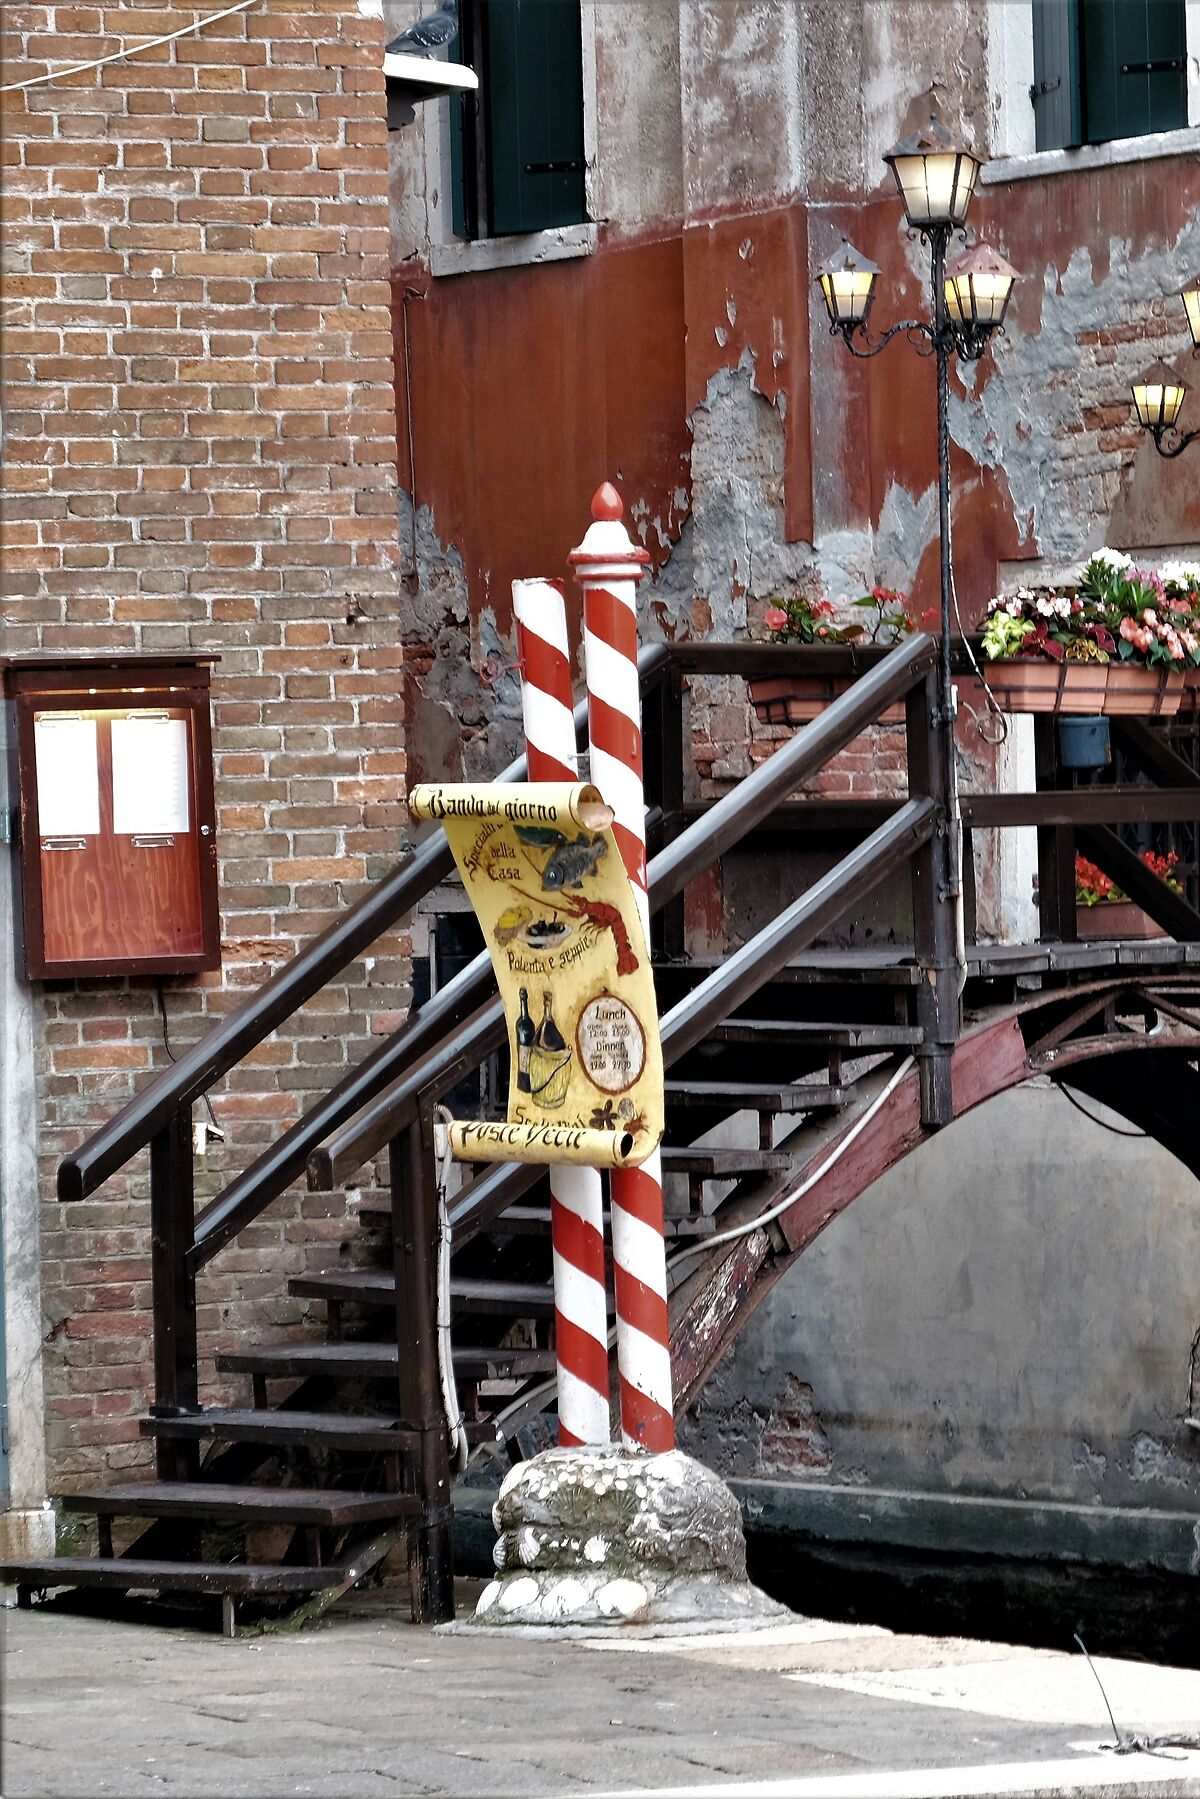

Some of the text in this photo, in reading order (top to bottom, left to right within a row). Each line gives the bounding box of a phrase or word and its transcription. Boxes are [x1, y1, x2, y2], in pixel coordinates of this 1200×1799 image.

[505, 798, 557, 822] giorno
[491, 842, 516, 859] della
[486, 862, 521, 881] Casa
[507, 935, 591, 973] Polenta e seppie
[595, 1005, 626, 1020] Lunch
[596, 1040, 625, 1052] Dinner
